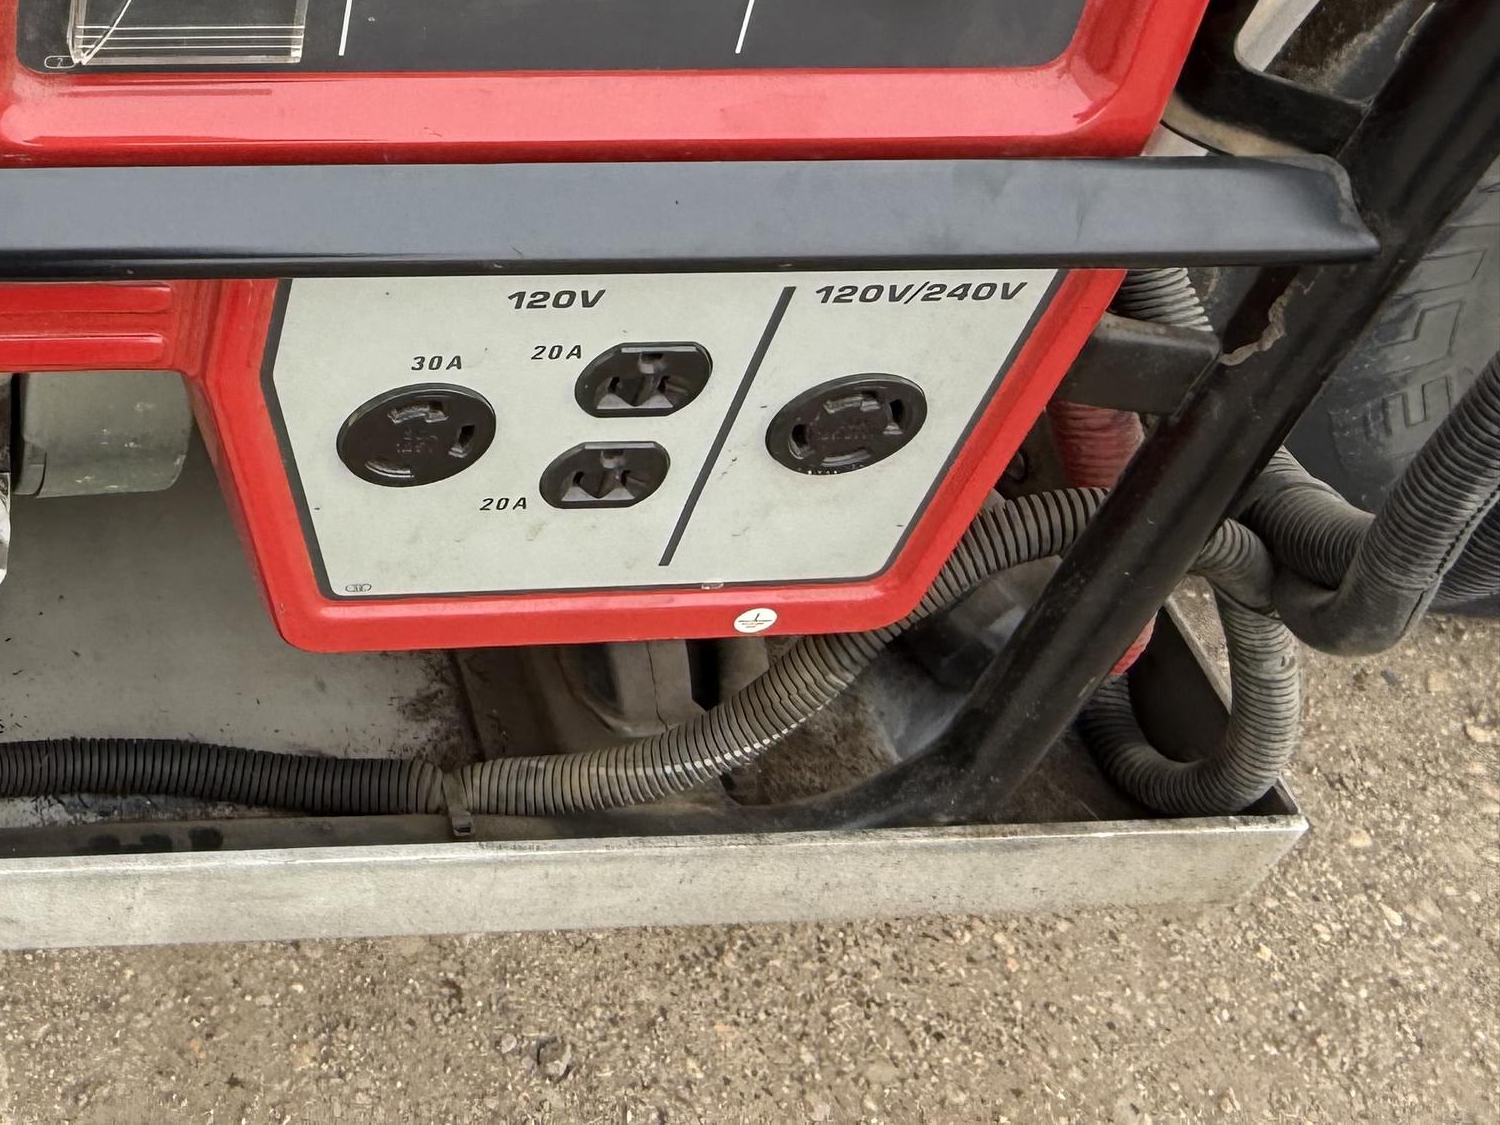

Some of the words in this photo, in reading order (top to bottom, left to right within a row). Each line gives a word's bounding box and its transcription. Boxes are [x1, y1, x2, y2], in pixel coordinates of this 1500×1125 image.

[507, 288, 606, 310] 120V
[814, 280, 1028, 306] 120V/240V
[530, 344, 583, 361] 20A
[410, 354, 464, 372] 30A
[479, 496, 529, 512] 20A
